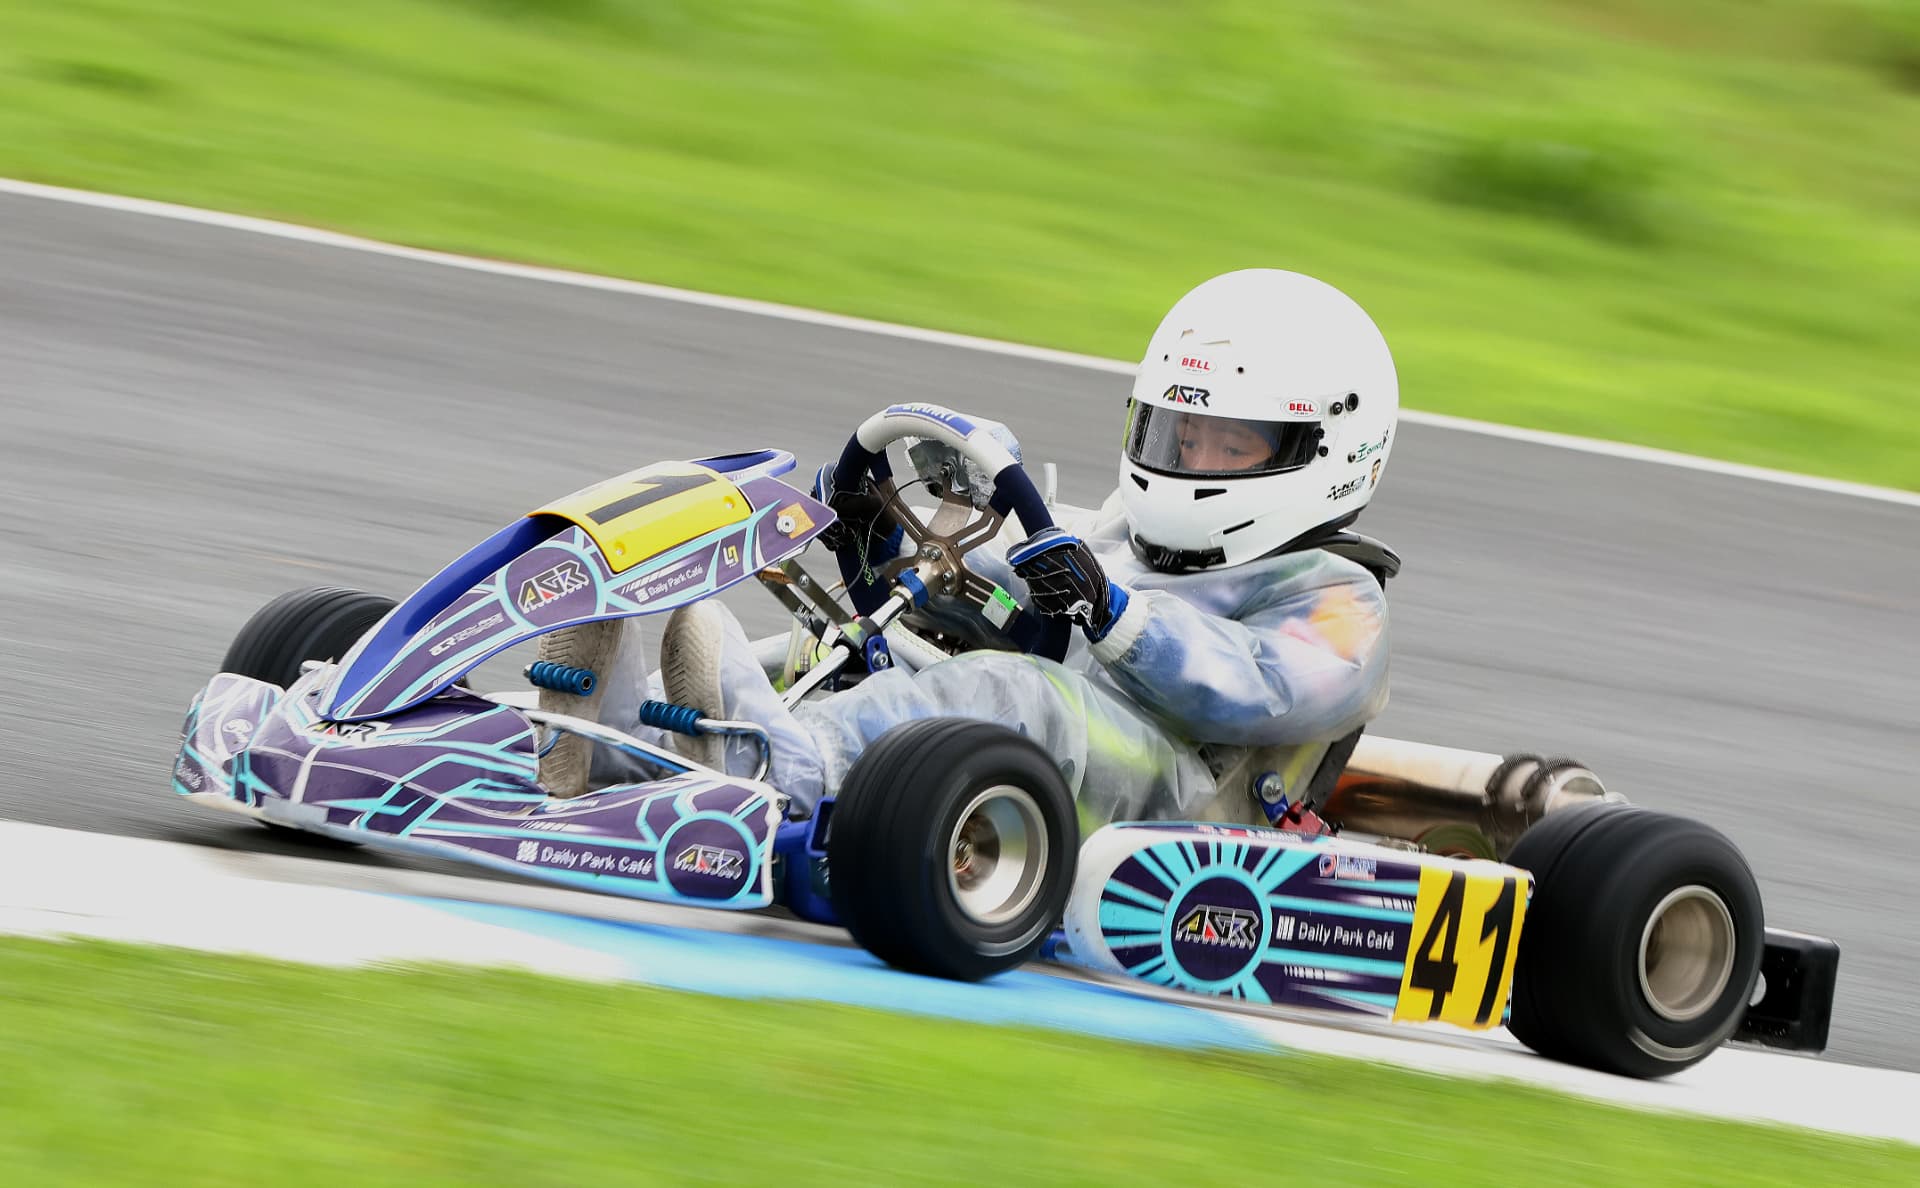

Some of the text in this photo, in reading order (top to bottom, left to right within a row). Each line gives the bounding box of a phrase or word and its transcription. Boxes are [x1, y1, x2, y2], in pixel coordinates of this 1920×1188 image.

[1181, 357, 1211, 371] BELL
[1289, 402, 1314, 412] BELL
[585, 473, 717, 526] 1
[647, 561, 703, 596] Daily Park Café
[540, 846, 653, 875] Daily Park Café
[1298, 921, 1395, 951] Daily Park Café
[1409, 870, 1517, 1025] 41
